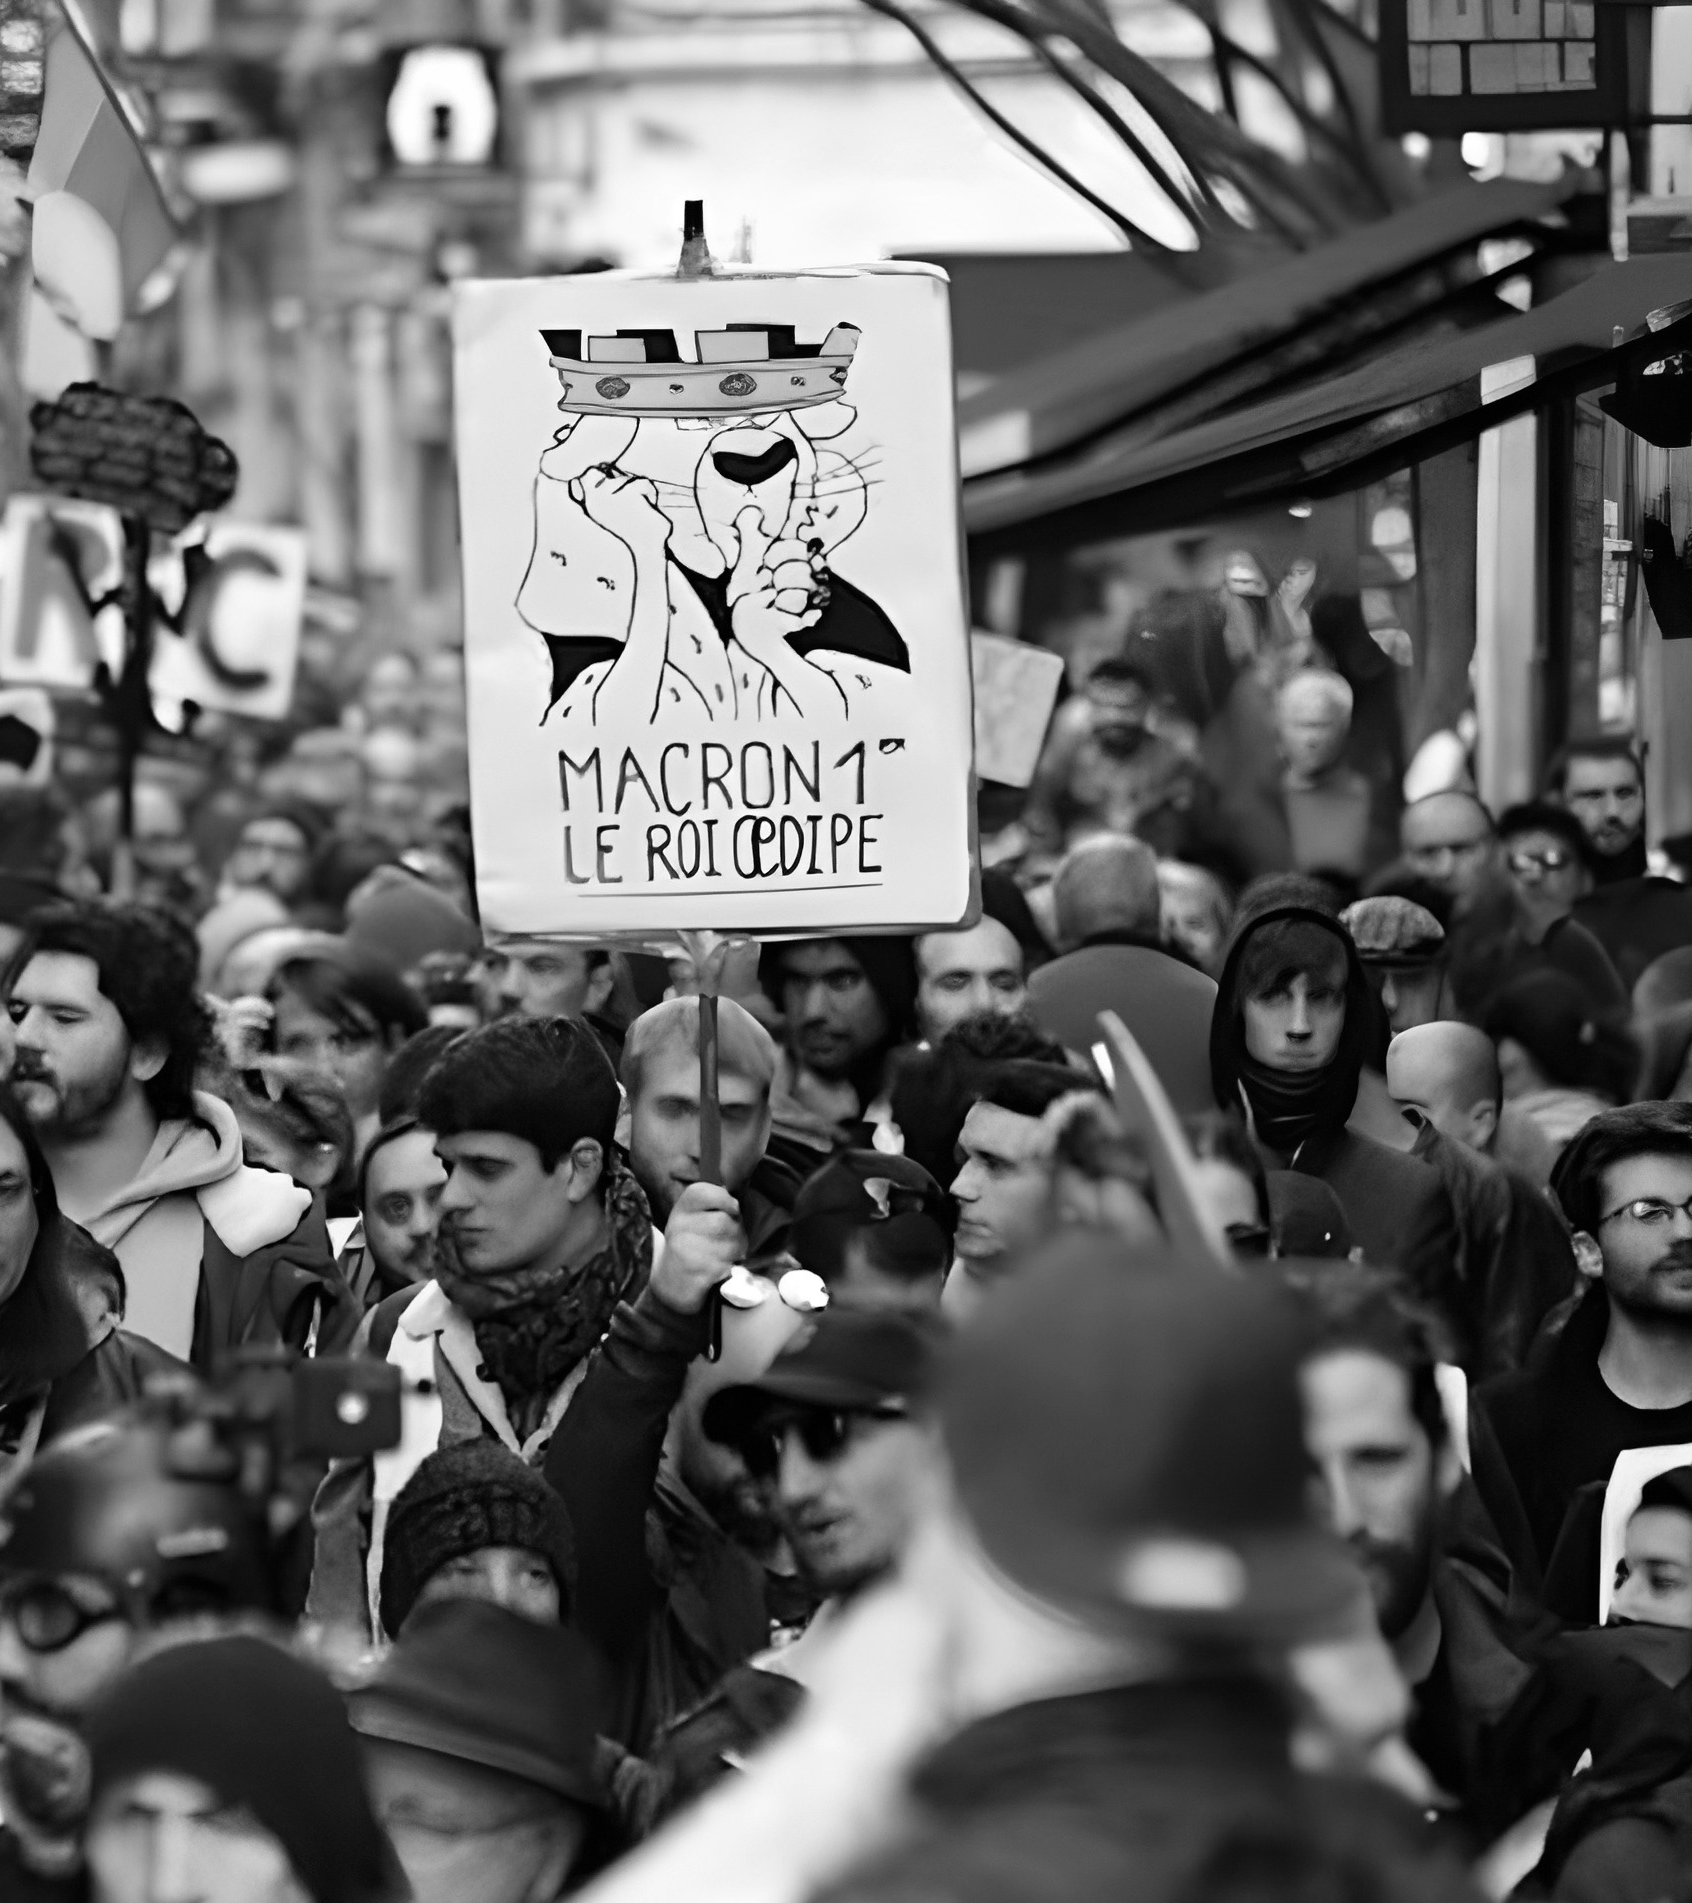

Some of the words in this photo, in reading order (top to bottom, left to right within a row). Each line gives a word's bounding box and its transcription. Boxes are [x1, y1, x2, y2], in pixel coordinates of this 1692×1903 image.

[558, 740, 821, 817] MACRON
[563, 824, 624, 885] LE
[645, 820, 722, 883] ROI
